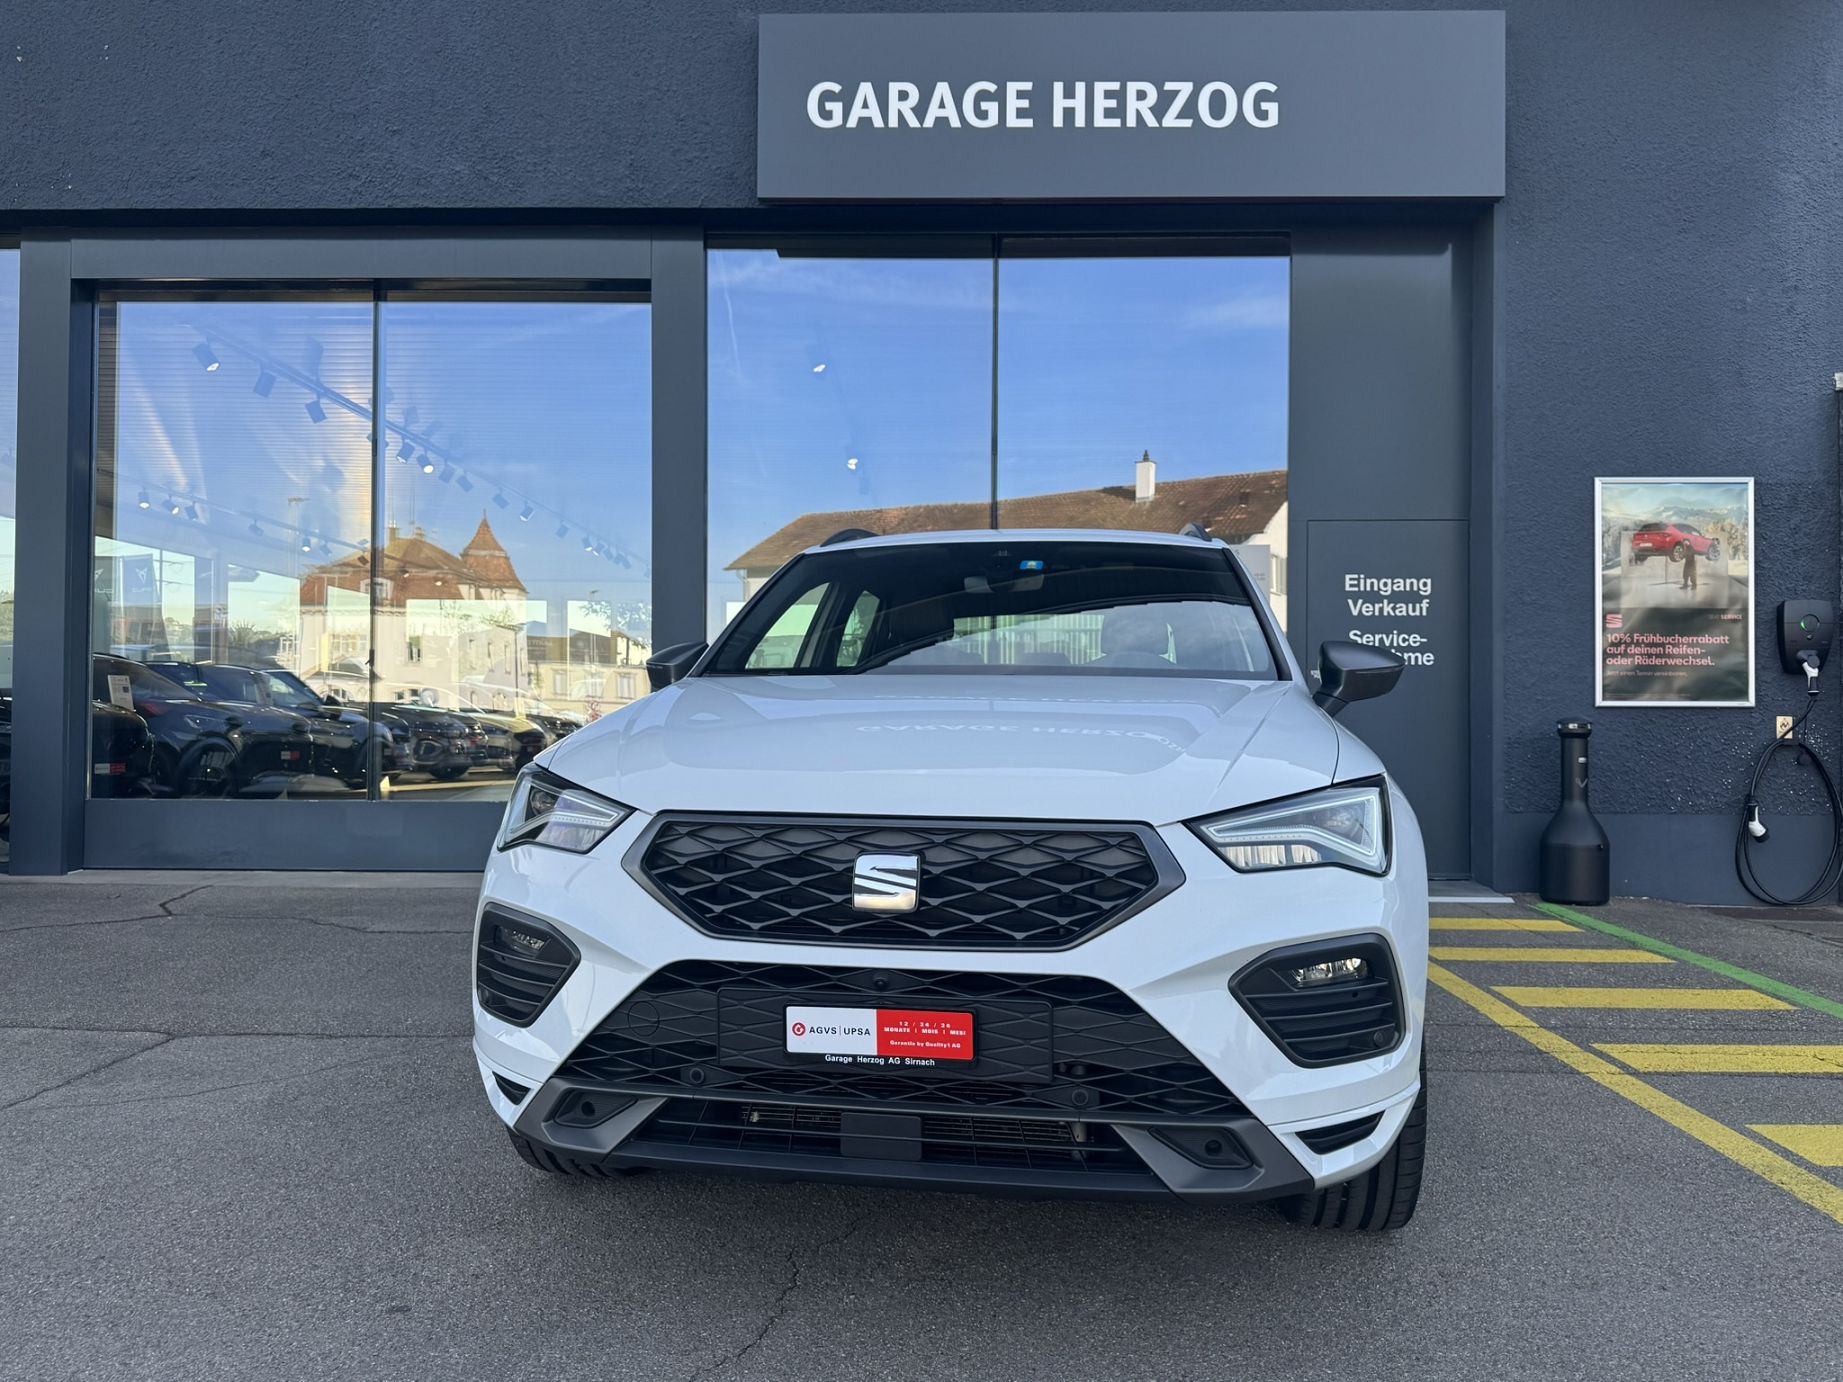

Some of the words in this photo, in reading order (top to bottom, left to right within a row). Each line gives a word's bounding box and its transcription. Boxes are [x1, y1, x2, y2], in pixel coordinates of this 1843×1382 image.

[806, 81, 1034, 129] GARAGE
[1052, 80, 1280, 128] HERZOG
[1344, 574, 1432, 595] Eingang
[1347, 599, 1430, 616] Verkauf
[1349, 630, 1428, 647] Service-
[1606, 634, 1631, 643] 10%
[1633, 633, 1730, 644] Frühbucherrabatt
[1606, 644, 1625, 654] auf
[1627, 645, 1663, 655] deinen
[1665, 645, 1706, 655] Reifen-
[1606, 656, 1633, 665] oder
[1634, 656, 1715, 666] Räderwechsel.
[809, 1026, 837, 1035] AGVS
[843, 1027, 871, 1036] UPSA
[824, 1054, 853, 1064] Garage
[857, 1055, 885, 1065] Herzog
[888, 1056, 901, 1065] AG
[905, 1057, 935, 1066] Sirnach
